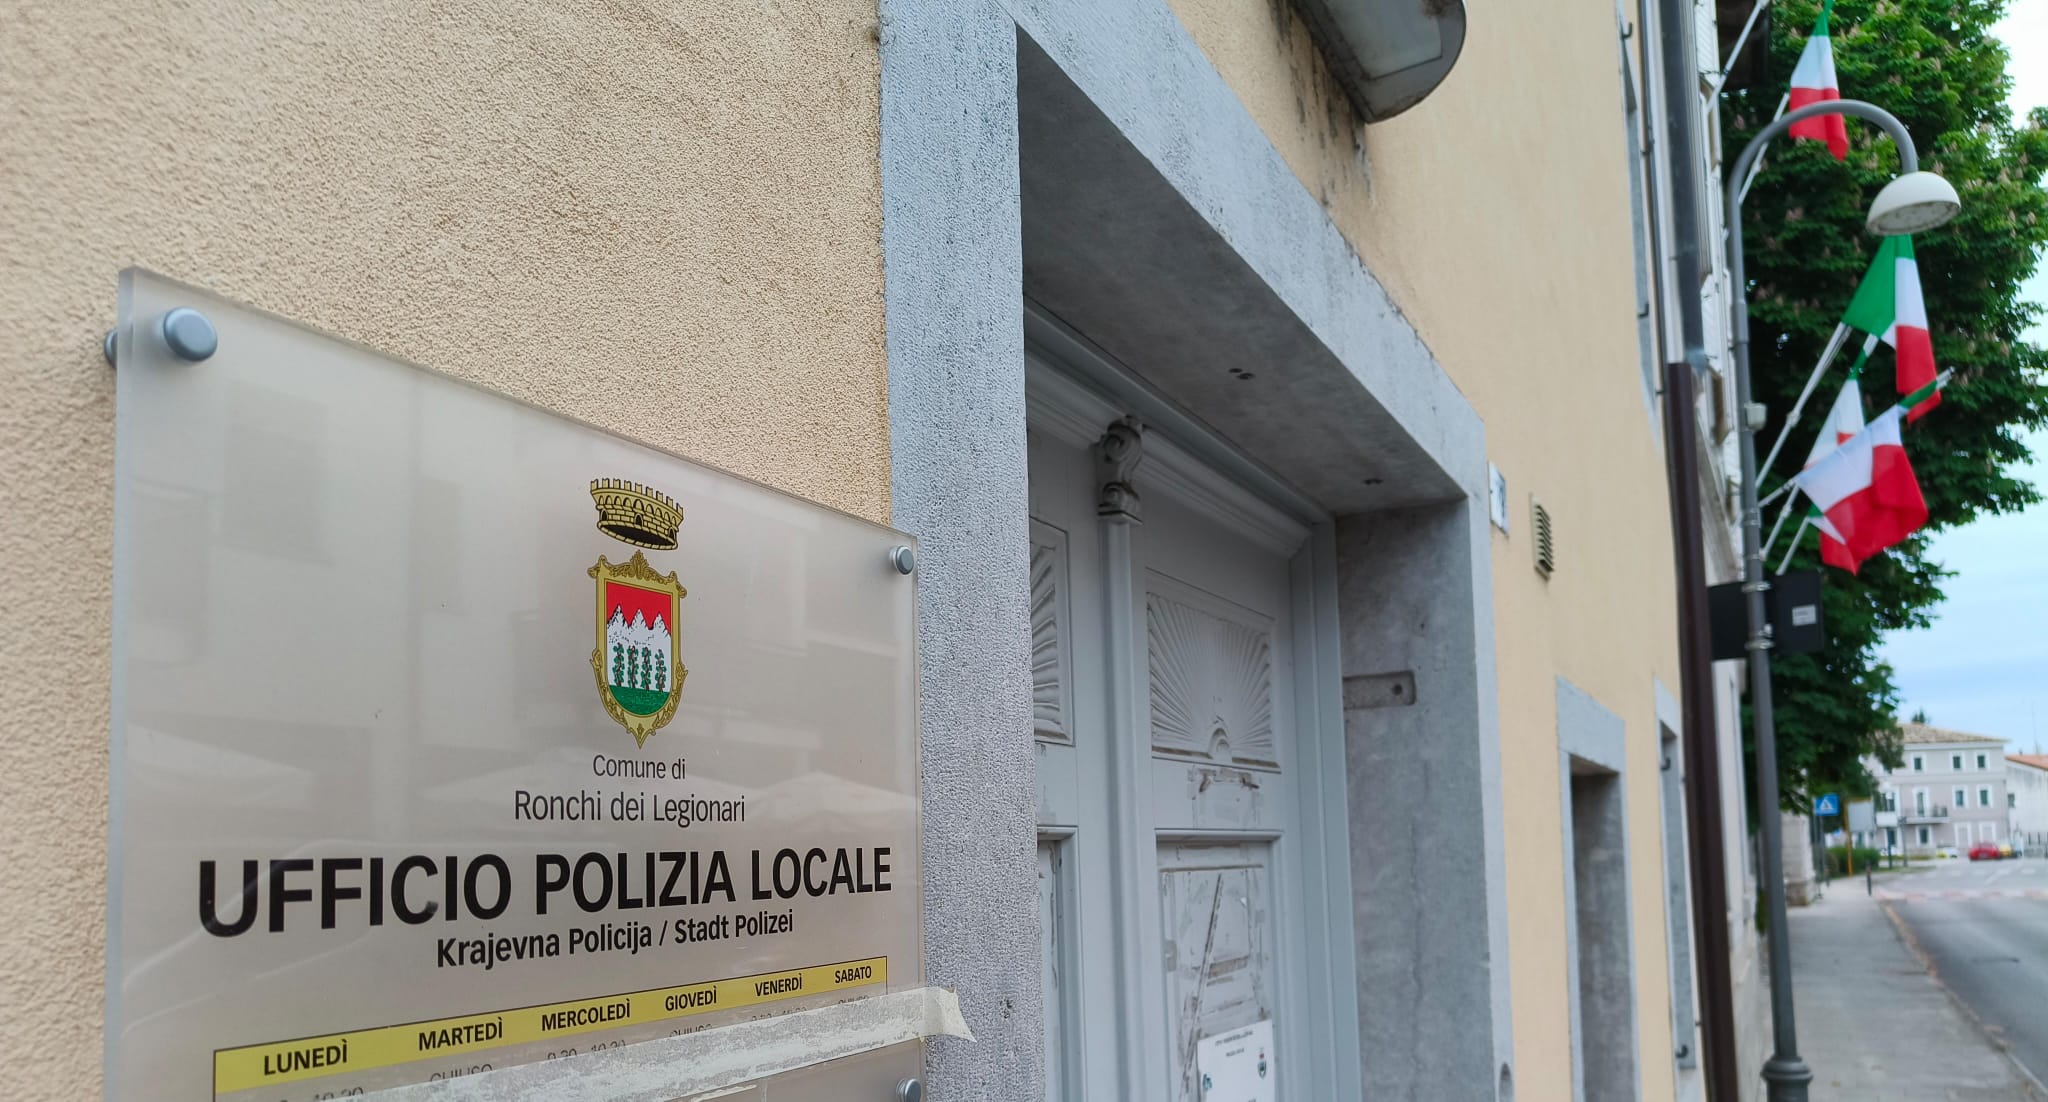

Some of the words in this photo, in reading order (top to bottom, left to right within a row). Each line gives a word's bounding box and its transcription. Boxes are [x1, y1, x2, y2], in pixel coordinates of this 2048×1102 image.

[593, 754, 667, 779] Comune
[671, 758, 687, 779] di
[514, 790, 601, 821] Ronchi
[610, 791, 645, 821] dei
[653, 794, 745, 828] Legionari
[199, 853, 512, 938] UFFICIO
[536, 850, 737, 915] POLIZIA
[751, 846, 893, 901] LOCALE
[436, 932, 560, 970] Krajevna
[568, 923, 652, 954] Policija
[658, 920, 668, 946] /
[674, 914, 731, 944] Stadt
[735, 908, 794, 938] Polizei
[263, 1038, 348, 1076] LUNEDÌ
[418, 1016, 503, 1051] MARTEDÌ
[541, 998, 631, 1032] MERCOLEDÌ
[665, 985, 718, 1012] GIOVEDÌ
[755, 972, 803, 997] VENERDÌ
[834, 965, 873, 984] SABATO
